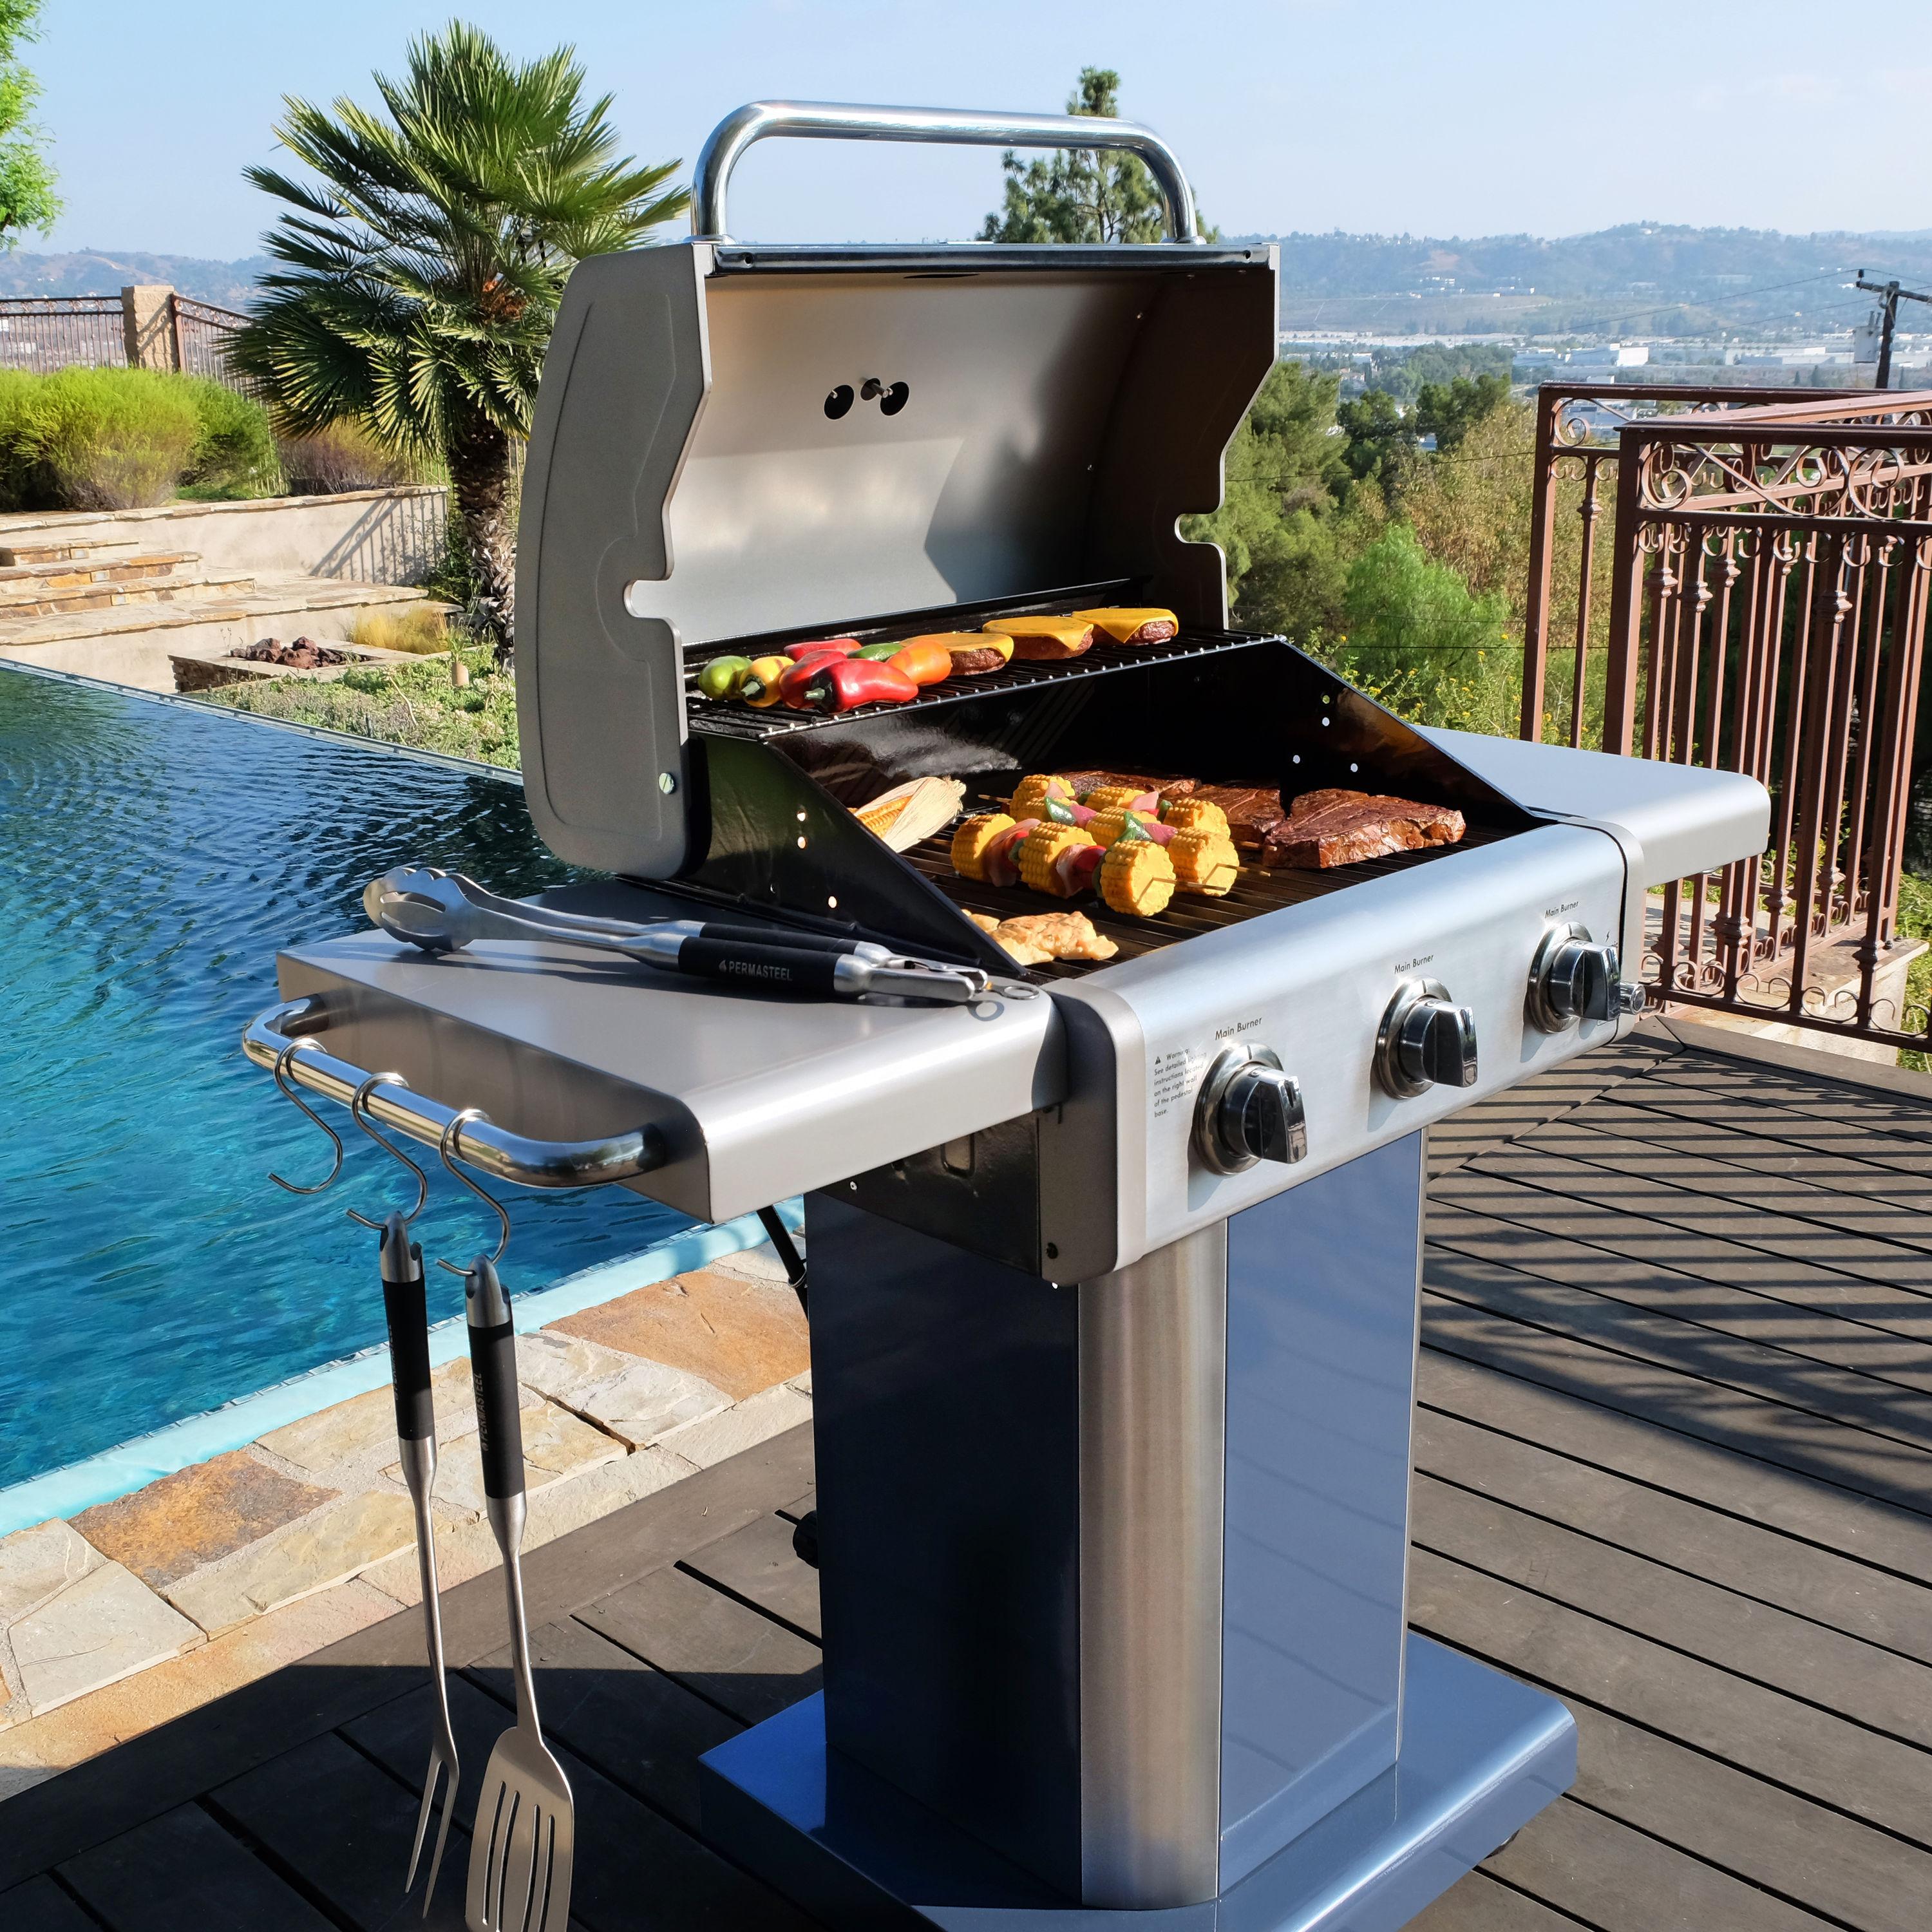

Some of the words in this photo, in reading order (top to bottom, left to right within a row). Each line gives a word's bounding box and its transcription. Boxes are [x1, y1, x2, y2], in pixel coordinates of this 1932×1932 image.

[1545, 907, 1558, 918] Main
[1560, 901, 1578, 913] Burner
[728, 960, 793, 981] PERMASTEEL
[1394, 961, 1411, 974] Main
[1412, 954, 1434, 968] Burner
[1215, 1027, 1235, 1041] Main
[1236, 1017, 1262, 1032] Burner
[1165, 1061, 1186, 1071] detailed
[1188, 1052, 1207, 1063] lighng
[1154, 1072, 1183, 1086] instructions
[1172, 1081, 1184, 1092] right
[1186, 1075, 1197, 1085] wall
[1154, 1099, 1160, 1107] of
[1171, 1087, 1193, 1103] pedestal
